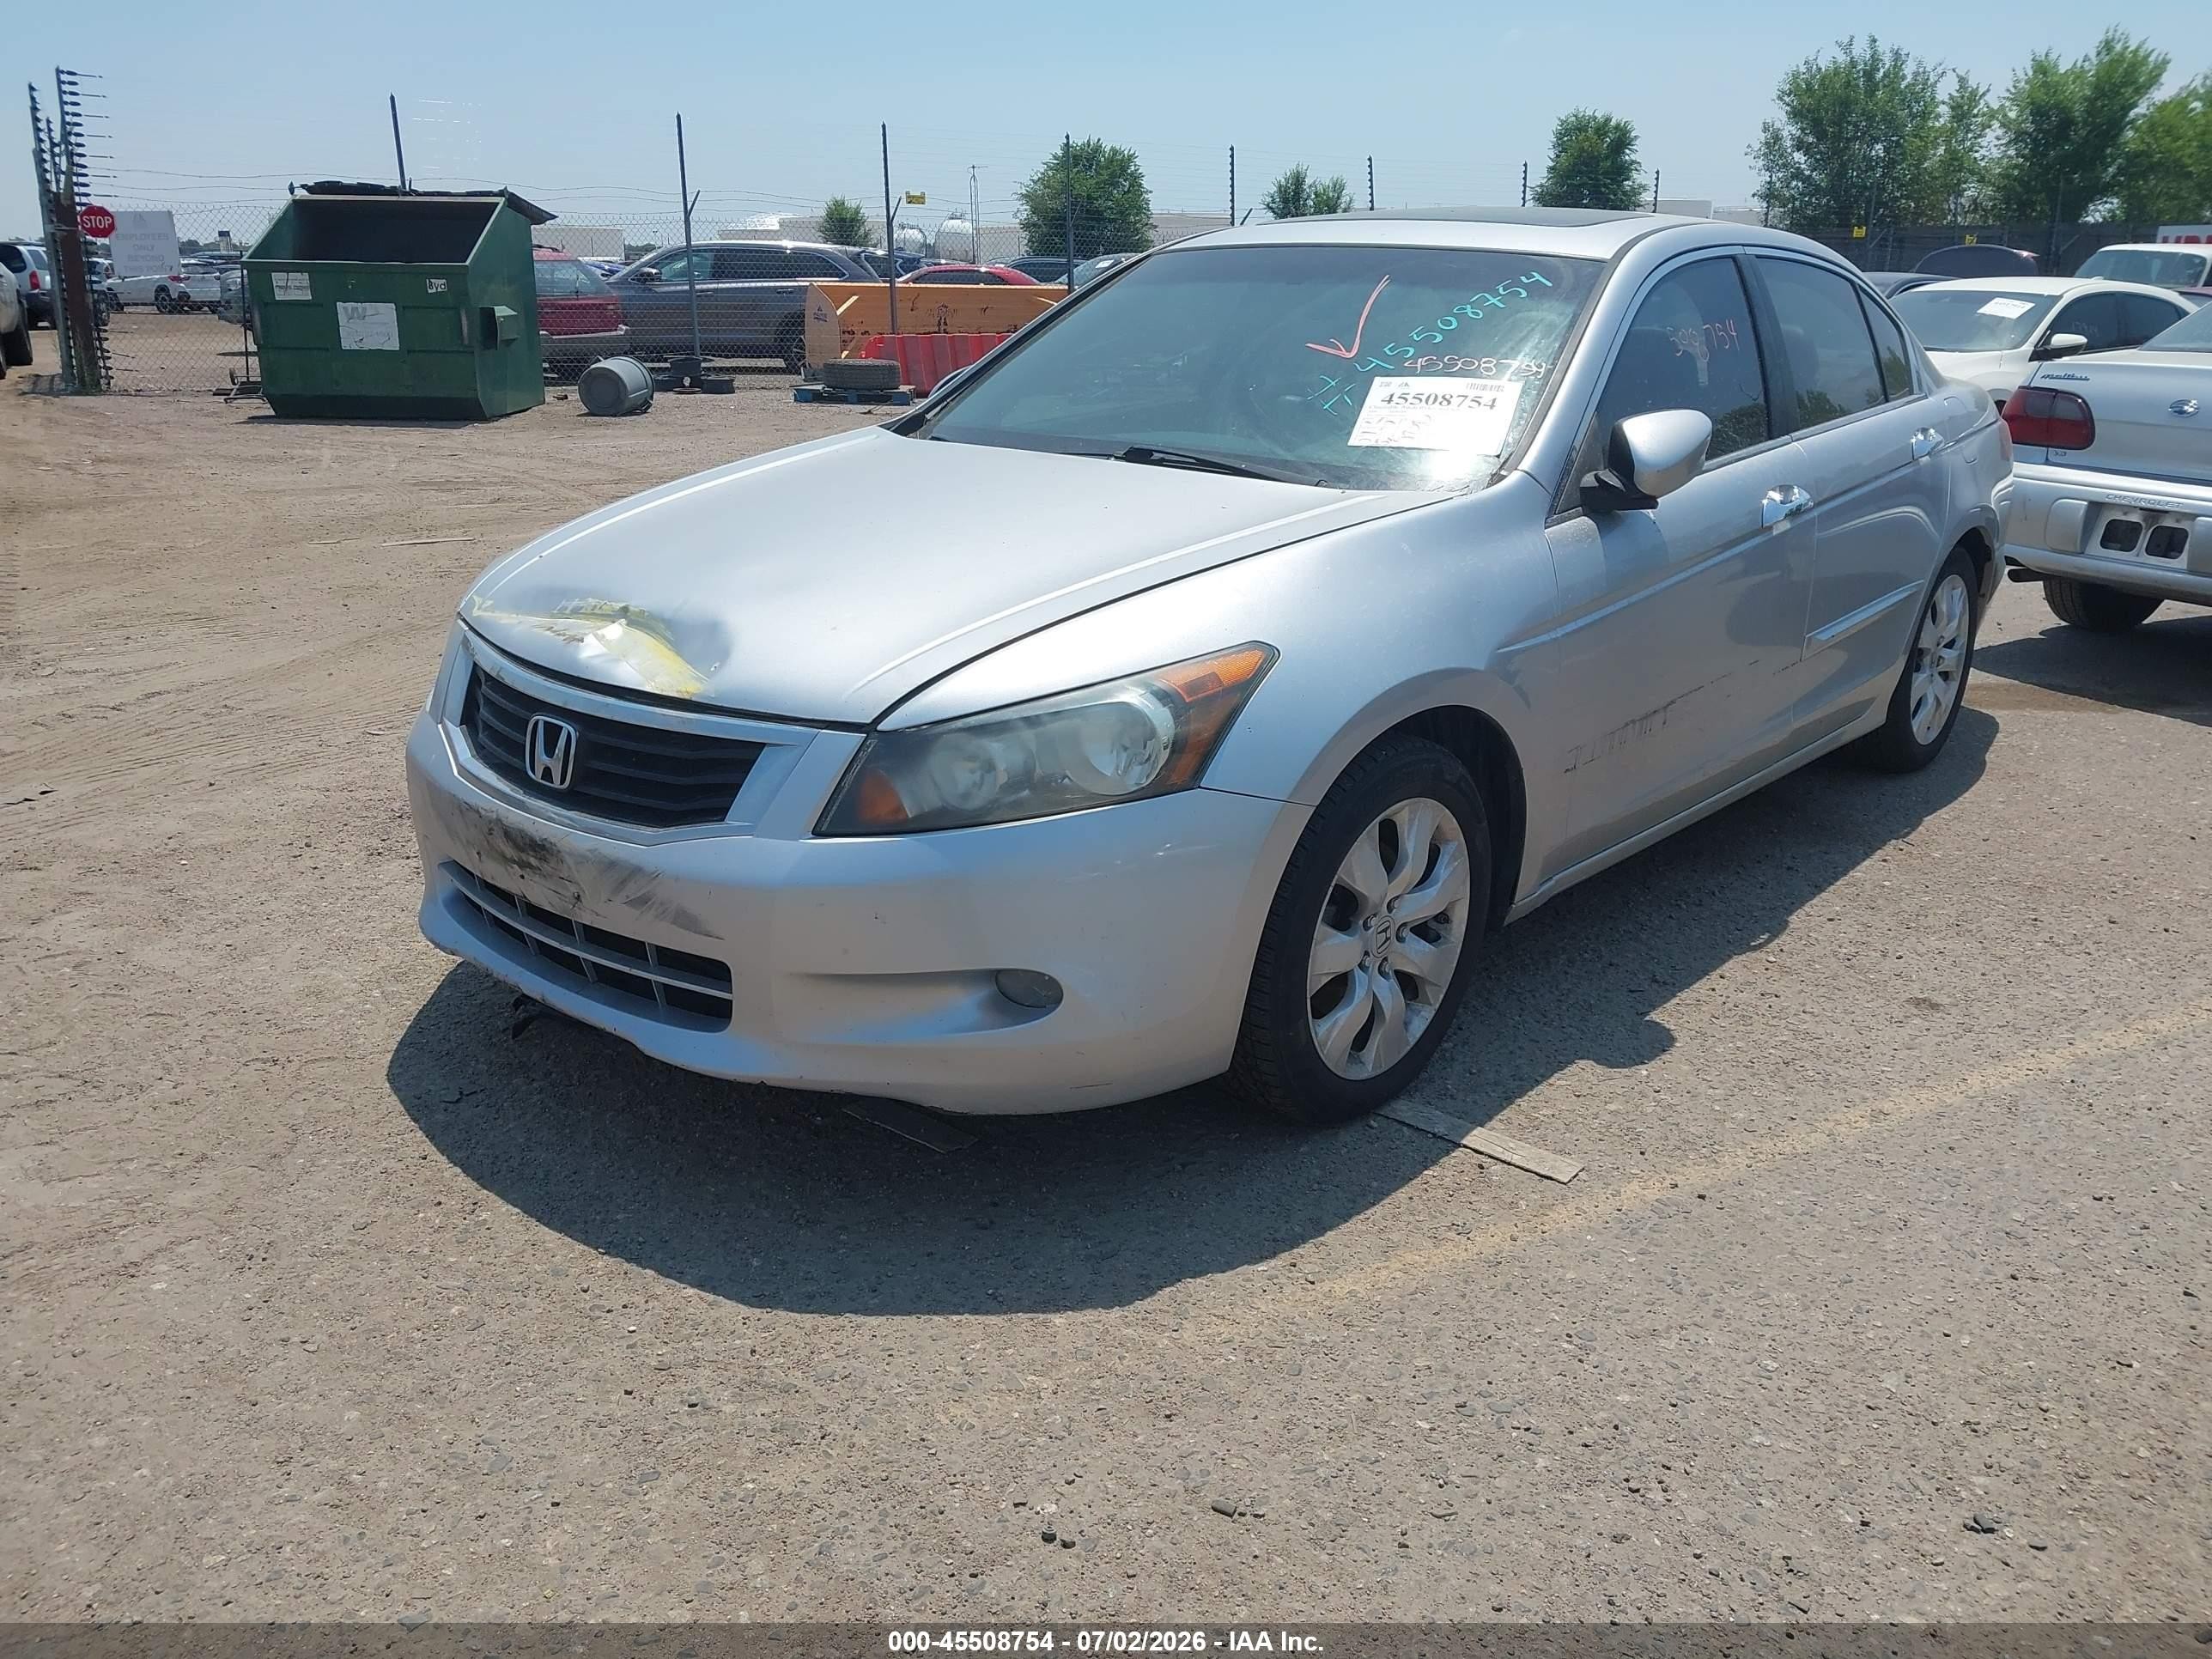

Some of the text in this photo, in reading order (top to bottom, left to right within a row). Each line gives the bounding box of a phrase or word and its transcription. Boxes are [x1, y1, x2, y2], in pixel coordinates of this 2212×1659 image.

[82, 216, 112, 228] STOP
[1381, 392, 1497, 410] 45508754
[2106, 494, 2185, 509] CHEVROLET
